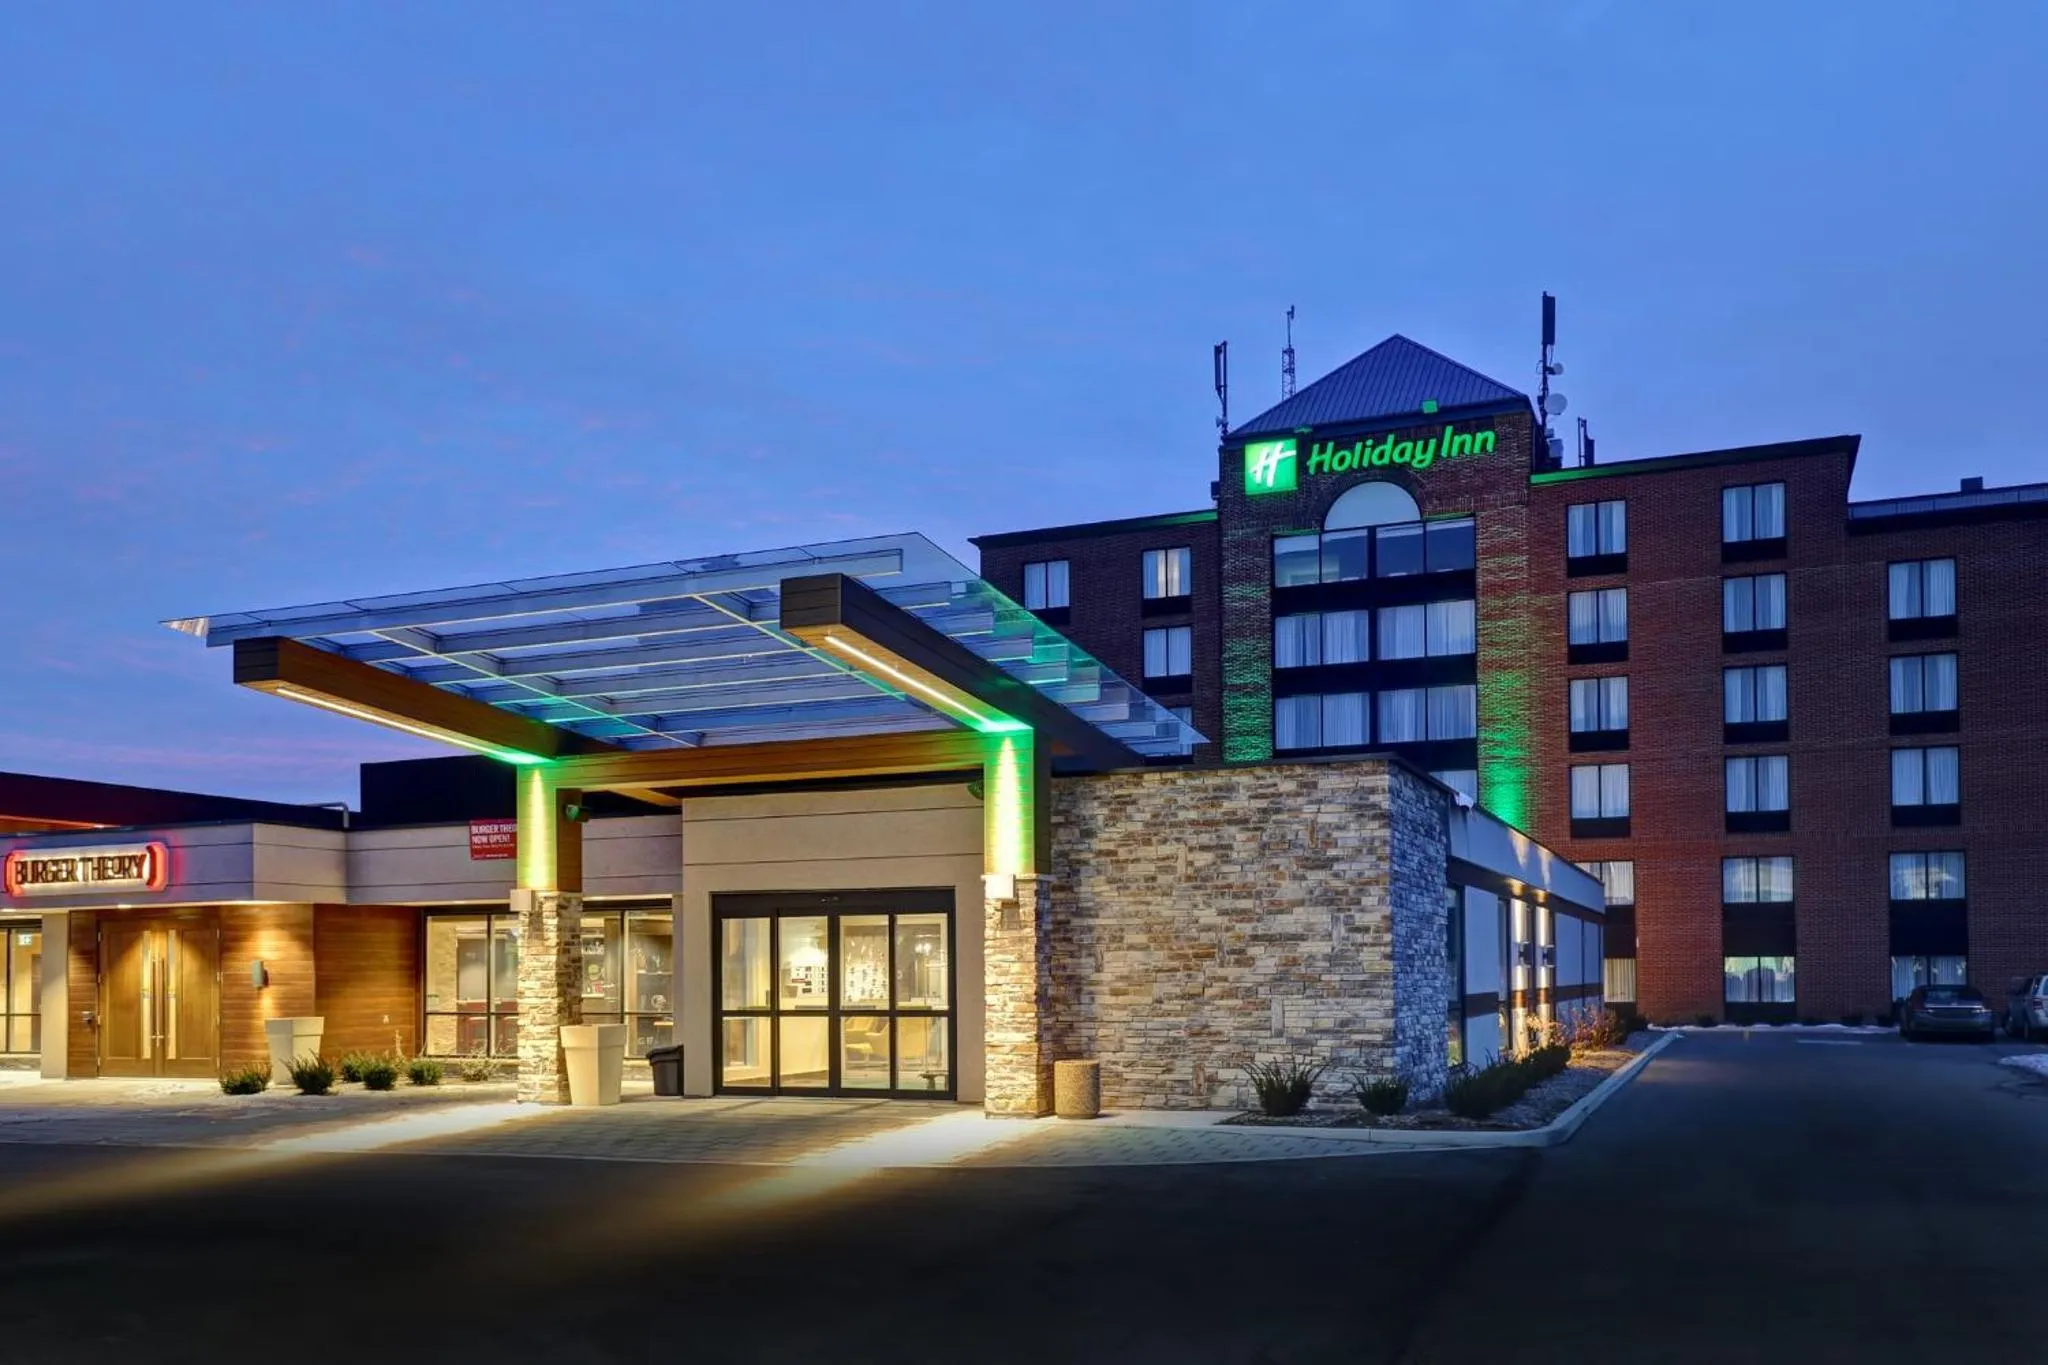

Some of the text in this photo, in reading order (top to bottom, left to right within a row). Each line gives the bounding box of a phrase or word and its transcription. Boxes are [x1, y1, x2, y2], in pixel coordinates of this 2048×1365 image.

[1306, 425, 1495, 475] Holiday Inn
[471, 824, 499, 834] BURGER
[471, 834, 510, 844] NOW OPEN!
[15, 854, 147, 885] BURGER THEORY
